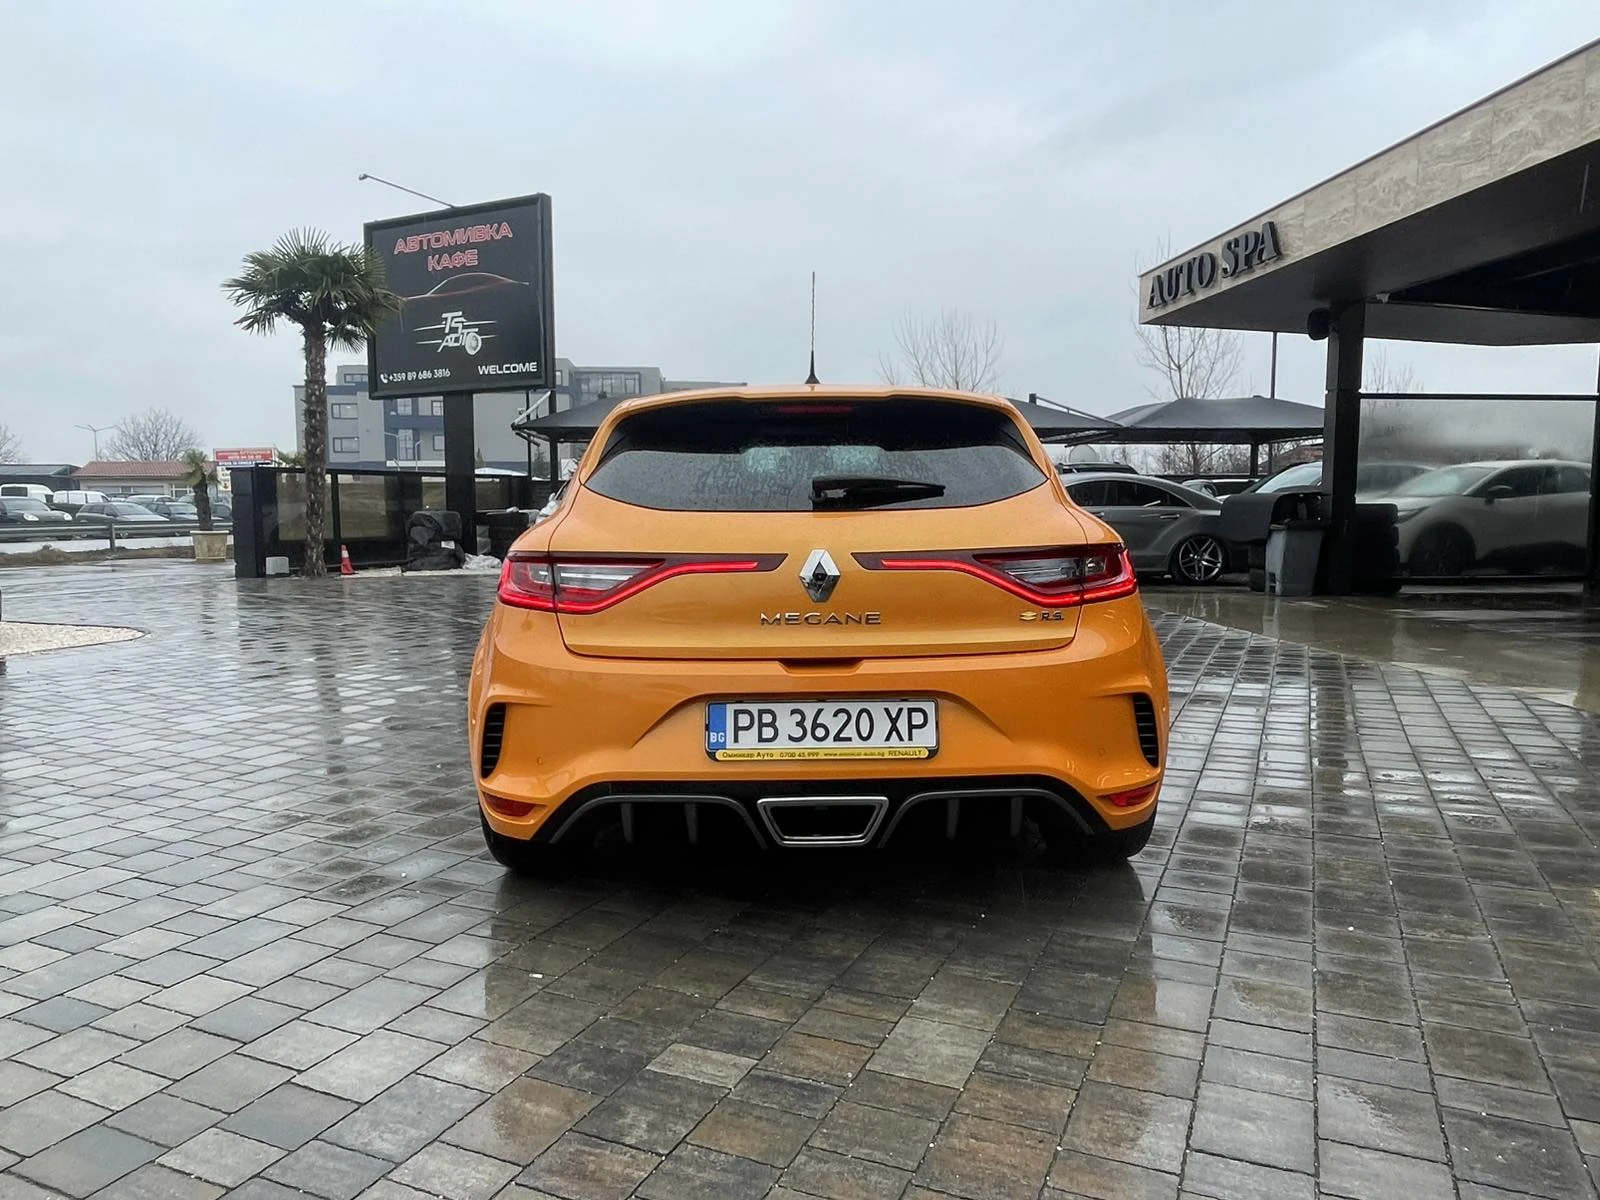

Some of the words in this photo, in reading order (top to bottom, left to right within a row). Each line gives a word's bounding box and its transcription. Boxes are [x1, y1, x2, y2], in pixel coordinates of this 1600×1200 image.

[394, 222, 513, 254] АВТОМИВКА
[427, 249, 479, 272] КАФЕ
[1146, 252, 1217, 309] AUTO
[1221, 221, 1281, 278] SPA
[389, 372, 407, 382] +359
[407, 371, 417, 381] 89
[433, 368, 451, 378] 3816
[478, 361, 538, 375] WELCOME
[760, 611, 882, 626] MEGANE
[733, 708, 780, 744] PB
[787, 707, 875, 743] 3620
[883, 706, 929, 742] XP
[709, 732, 726, 743] BG
